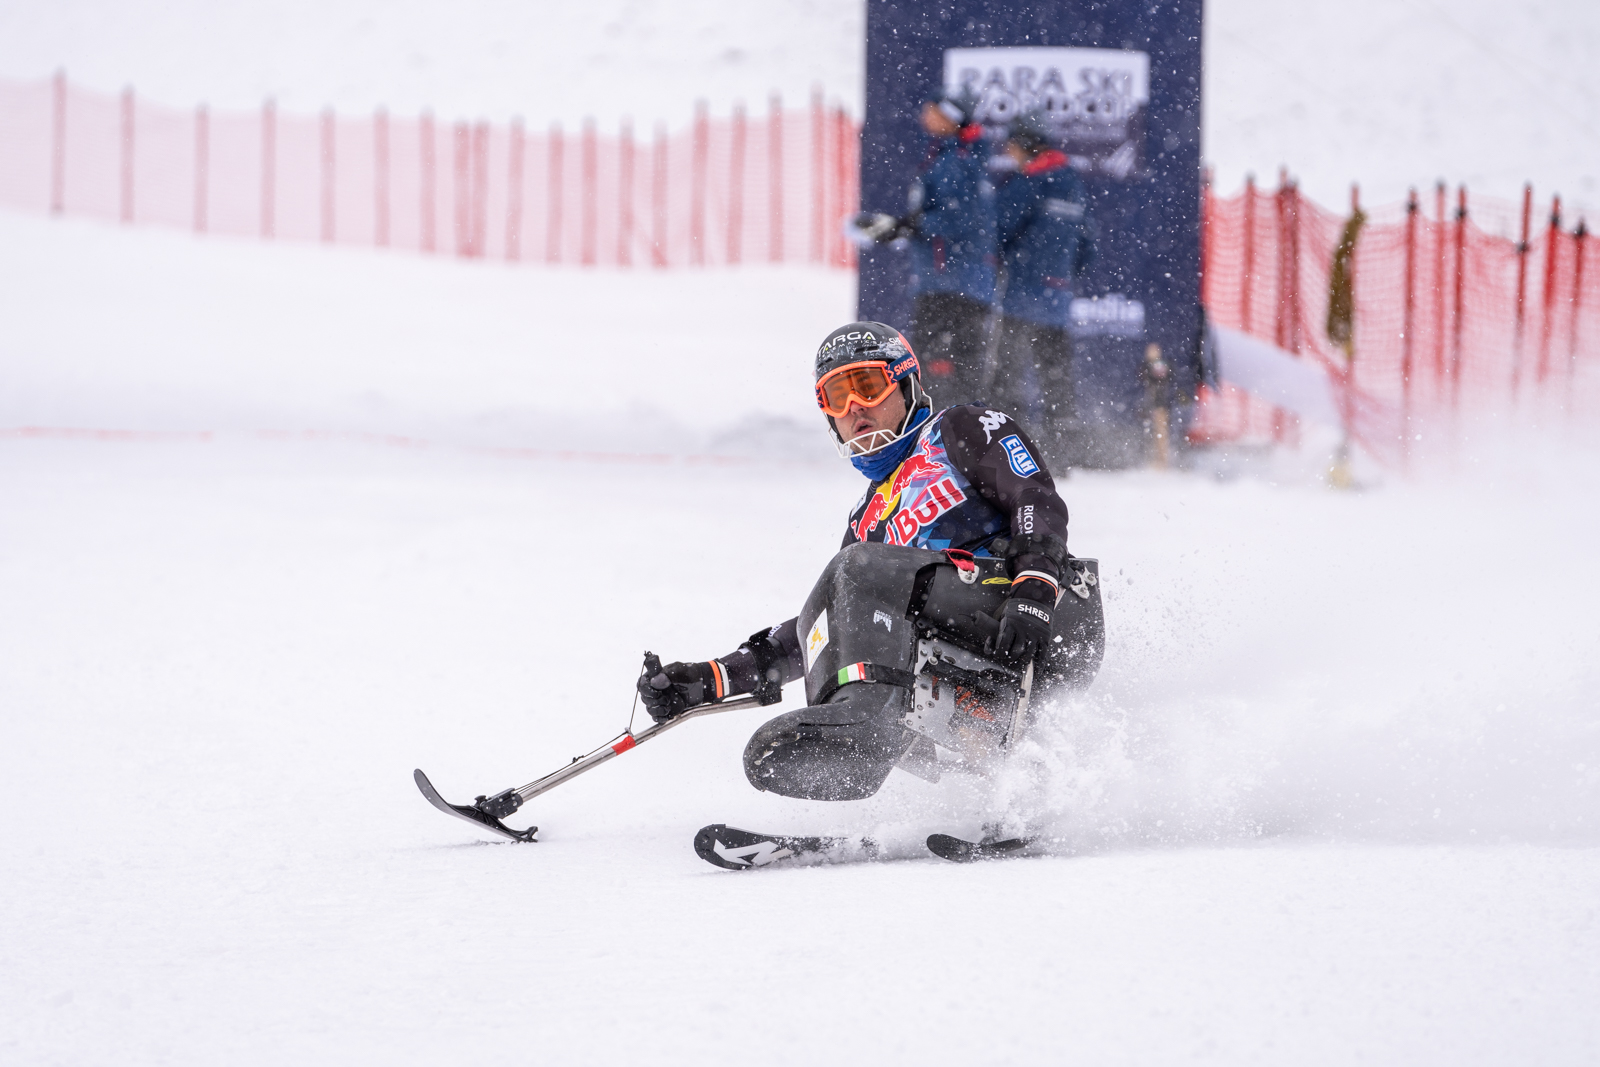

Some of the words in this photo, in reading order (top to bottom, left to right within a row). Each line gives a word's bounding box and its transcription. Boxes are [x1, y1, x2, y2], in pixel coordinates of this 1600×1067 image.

[959, 65, 1067, 97] PARA
[1079, 66, 1134, 98] SKI
[1005, 437, 1036, 474] ELAH
[893, 478, 965, 546] Bull
